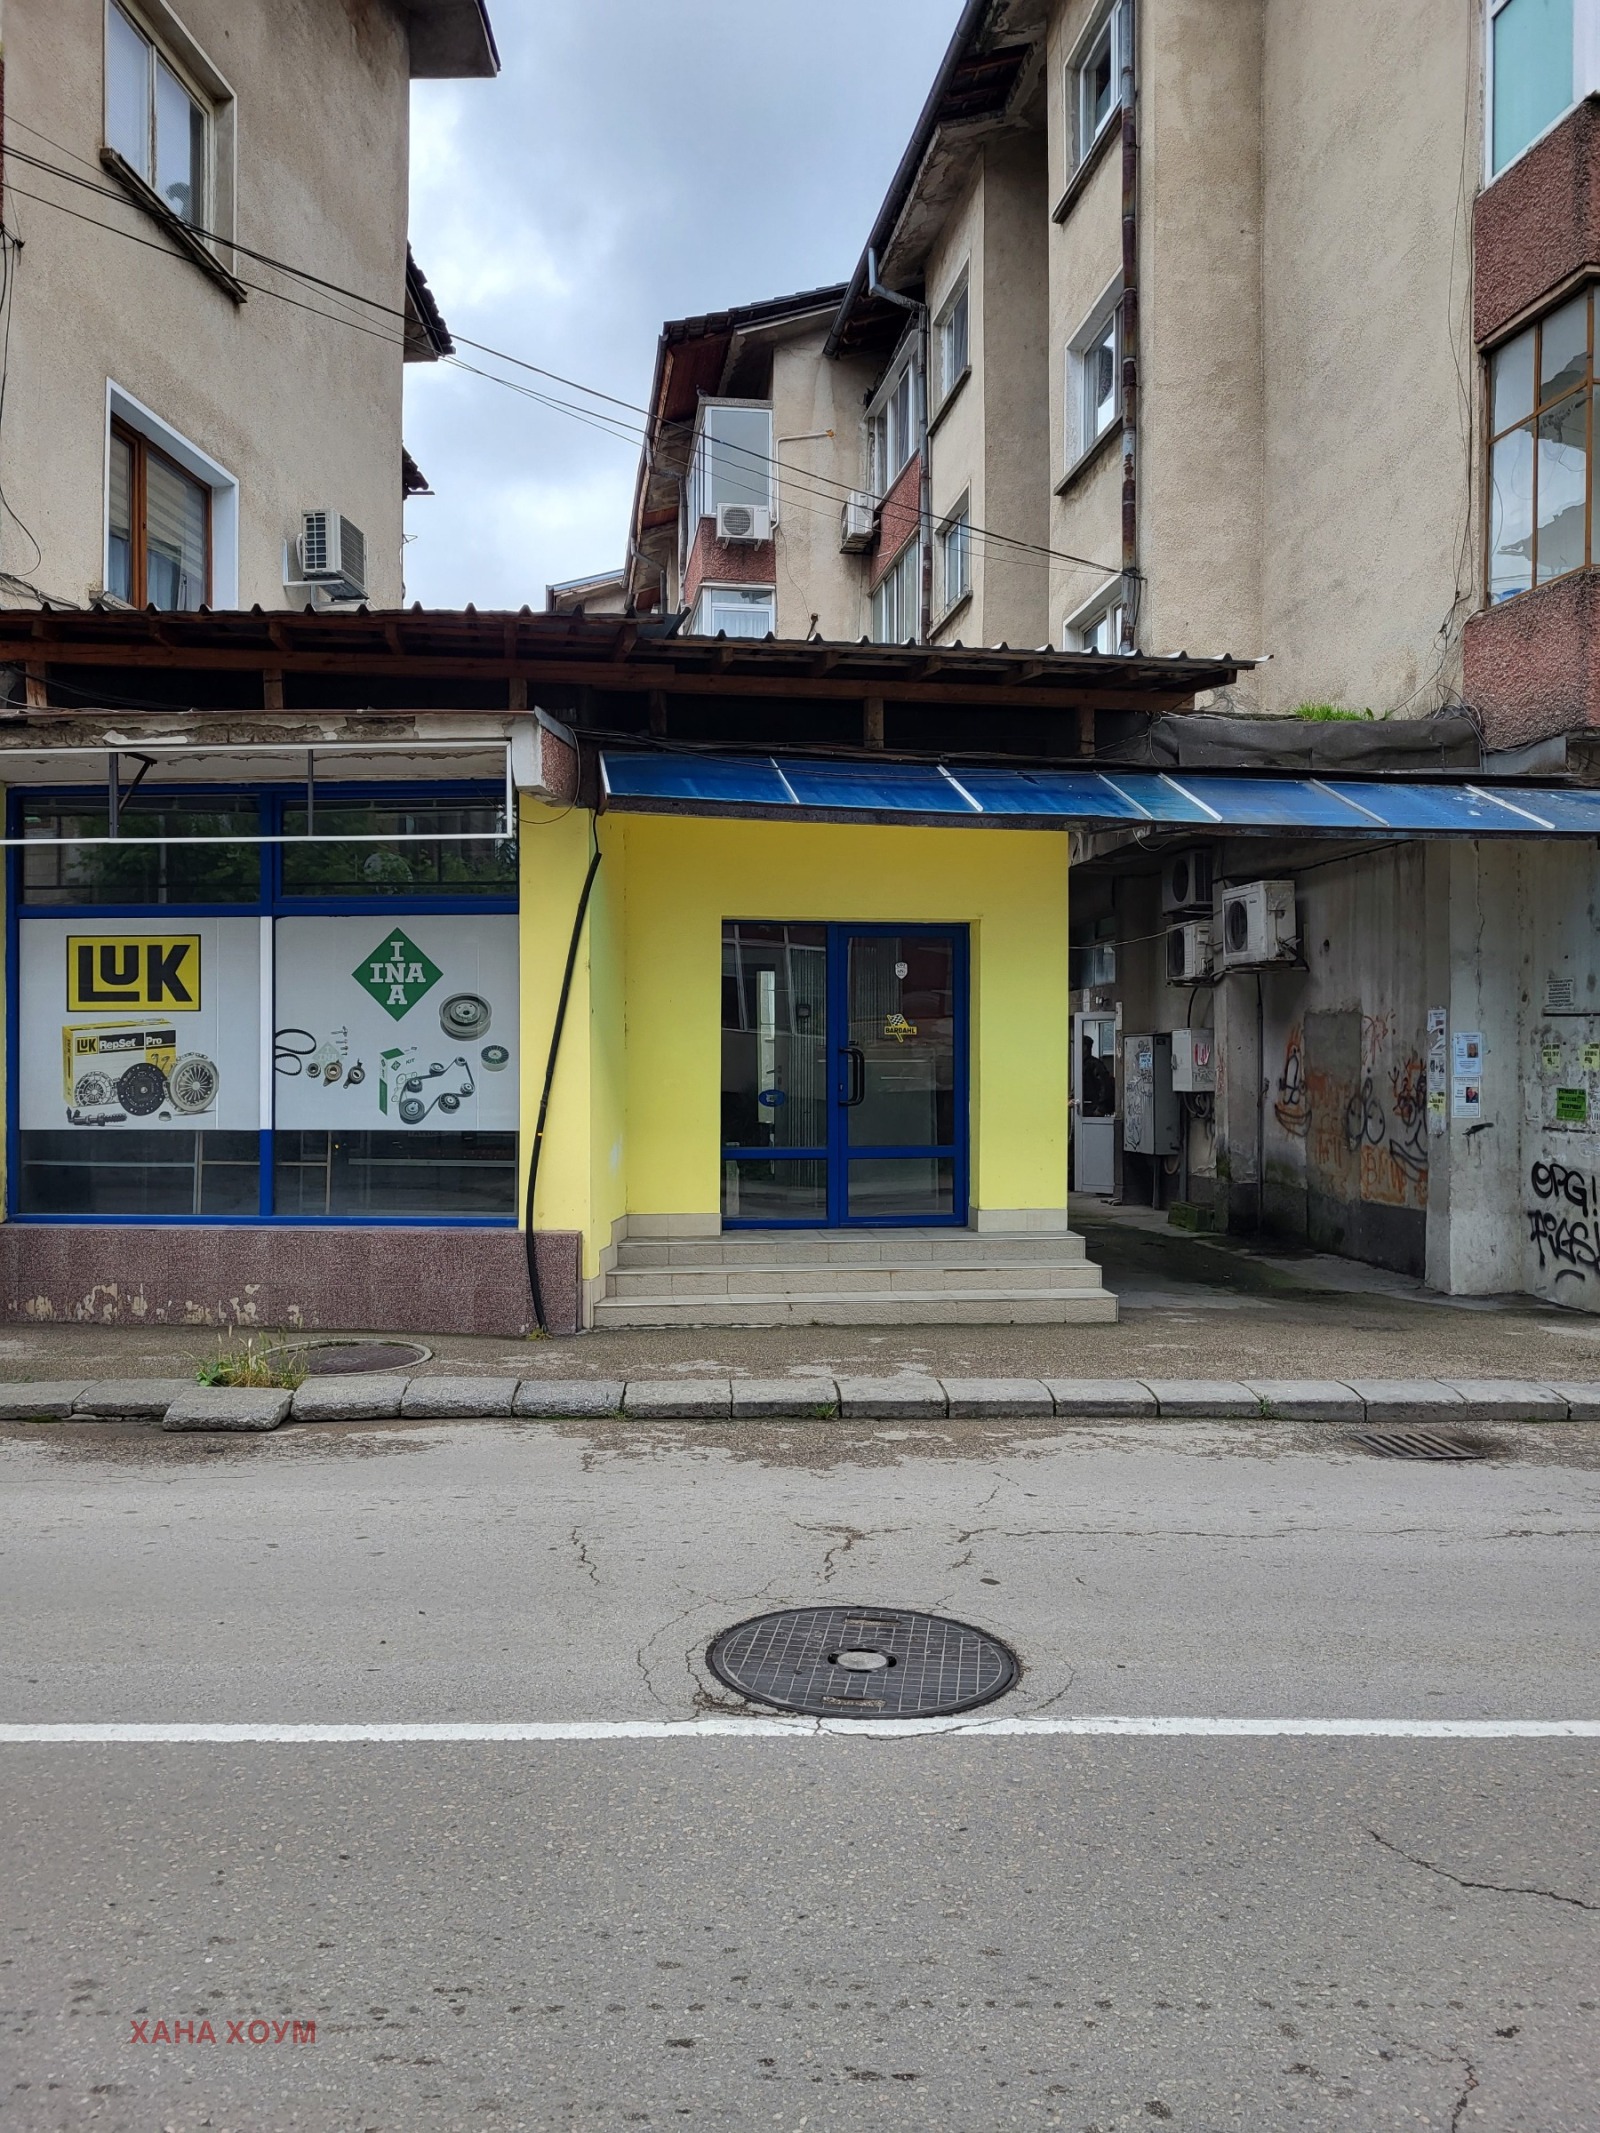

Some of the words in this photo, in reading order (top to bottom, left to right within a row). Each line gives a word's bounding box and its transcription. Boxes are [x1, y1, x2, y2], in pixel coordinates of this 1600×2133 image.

[369, 962, 427, 983] INA
[100, 1037, 136, 1049] RepSet
[146, 1036, 162, 1045] Pro
